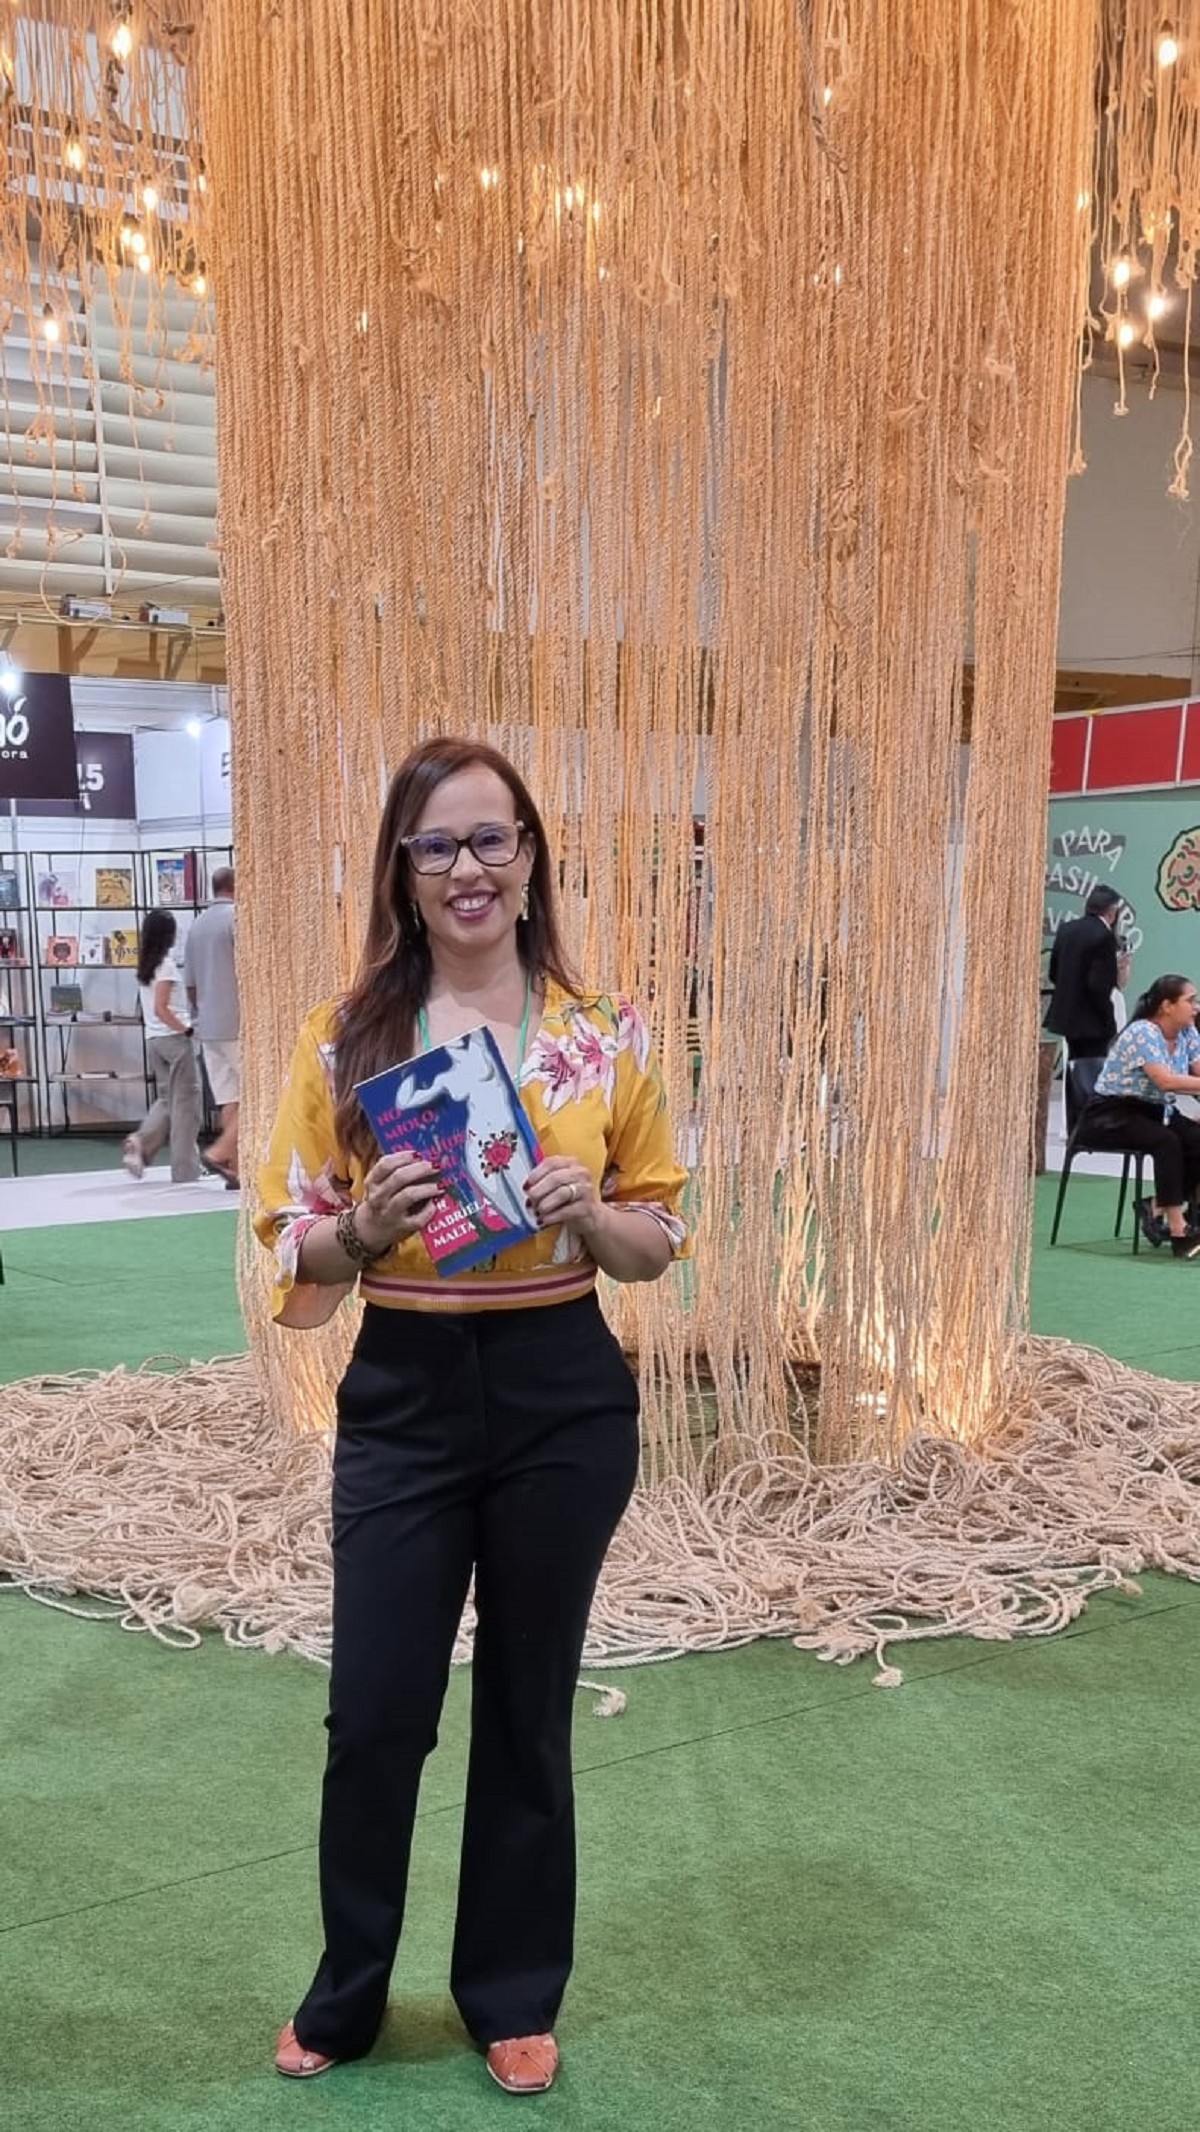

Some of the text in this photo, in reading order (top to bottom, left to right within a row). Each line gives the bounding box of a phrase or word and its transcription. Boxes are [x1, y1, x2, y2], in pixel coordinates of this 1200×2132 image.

[1060, 825, 1124, 872] PARA
[427, 1197, 492, 1235] GABRIELA
[433, 1221, 478, 1248] MALTA
